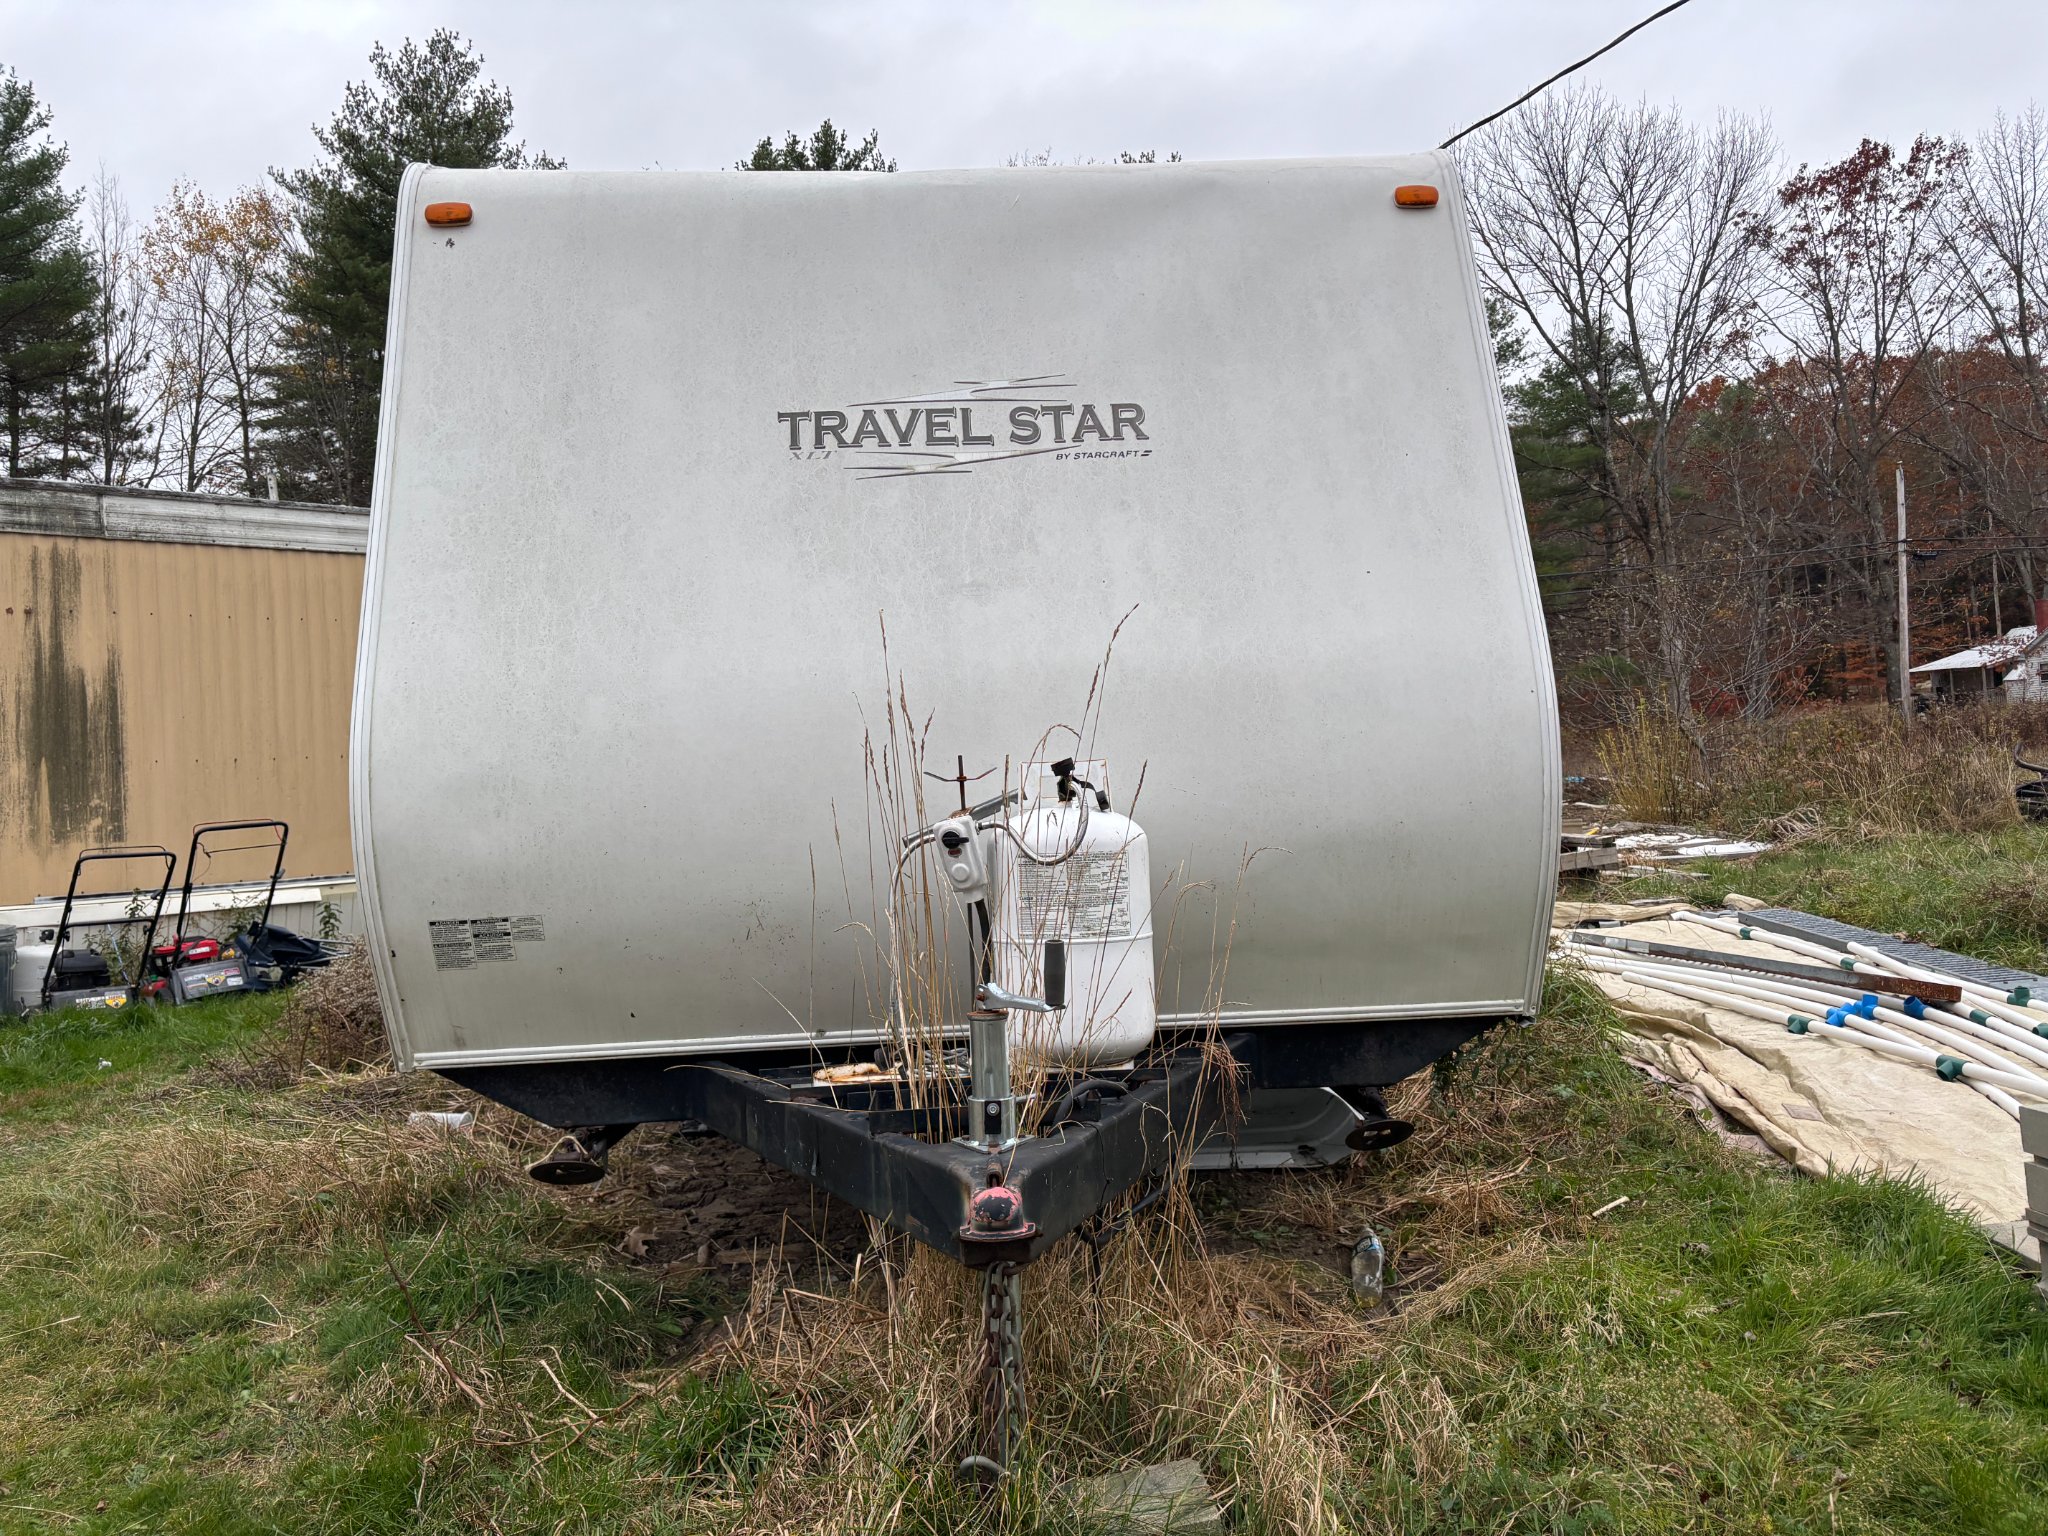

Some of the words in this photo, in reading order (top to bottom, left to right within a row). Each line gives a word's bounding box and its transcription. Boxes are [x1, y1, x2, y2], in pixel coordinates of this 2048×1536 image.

[777, 406, 994, 450] TRAVEL
[1008, 403, 1150, 445] STAR
[1056, 452, 1071, 461] BY
[1073, 450, 1140, 460] STARCRAFT
